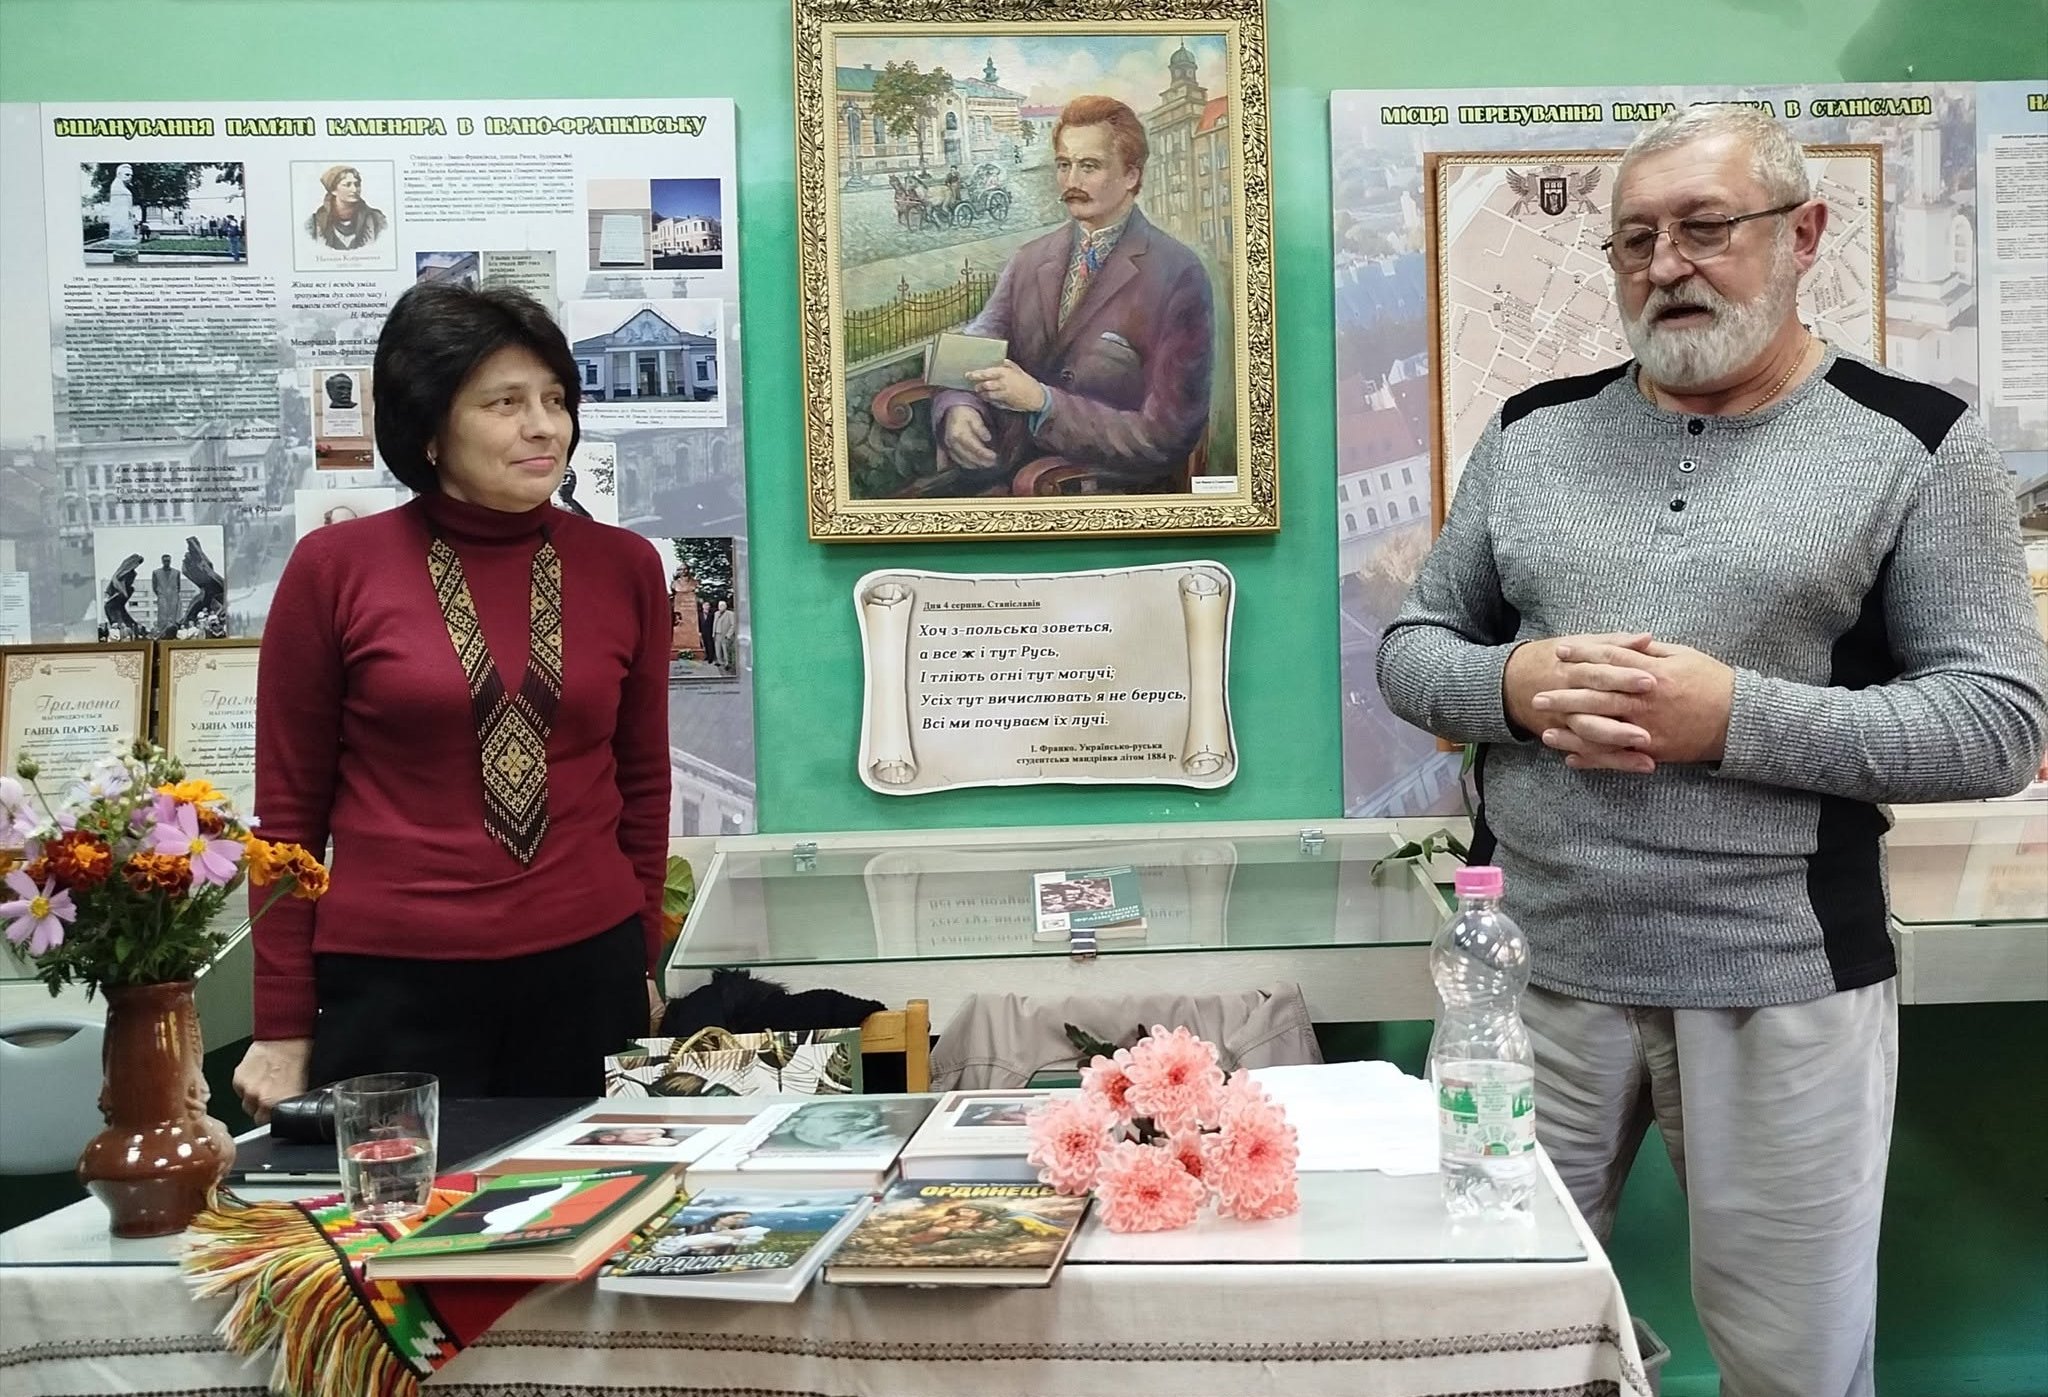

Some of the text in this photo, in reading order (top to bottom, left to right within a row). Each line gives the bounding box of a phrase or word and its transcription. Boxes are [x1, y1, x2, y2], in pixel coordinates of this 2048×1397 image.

[1381, 105, 1449, 126] МІСЦЯ
[1458, 104, 1603, 125] ПЕРЕБУВАННЯ
[1785, 100, 1801, 118] В
[1810, 96, 1932, 117] СТАНІСЛАВІ
[54, 115, 707, 139] ВШАНУВАННЯ ПАМ'ЯТІ КАМЕНЯРА В ІВАНО-ФРАНКІВСЬКУ
[944, 601, 949, 609] 4
[919, 622, 1113, 636] Хоч з-польська зоветься,
[920, 646, 1060, 660] а все ж і тут Русь,
[920, 667, 1115, 683] І тліють огні тут могучі;
[921, 694, 952, 707] Усіх
[957, 696, 984, 708] тут
[988, 693, 1092, 705] вичислювать
[1097, 693, 1105, 702] я
[1109, 692, 1127, 702] не
[231, 721, 257, 729] МИК
[922, 712, 1109, 730] Всі ми почуваєм їх лучі.
[24, 726, 60, 735] ГАННА
[1147, 753, 1167, 761] 1884
